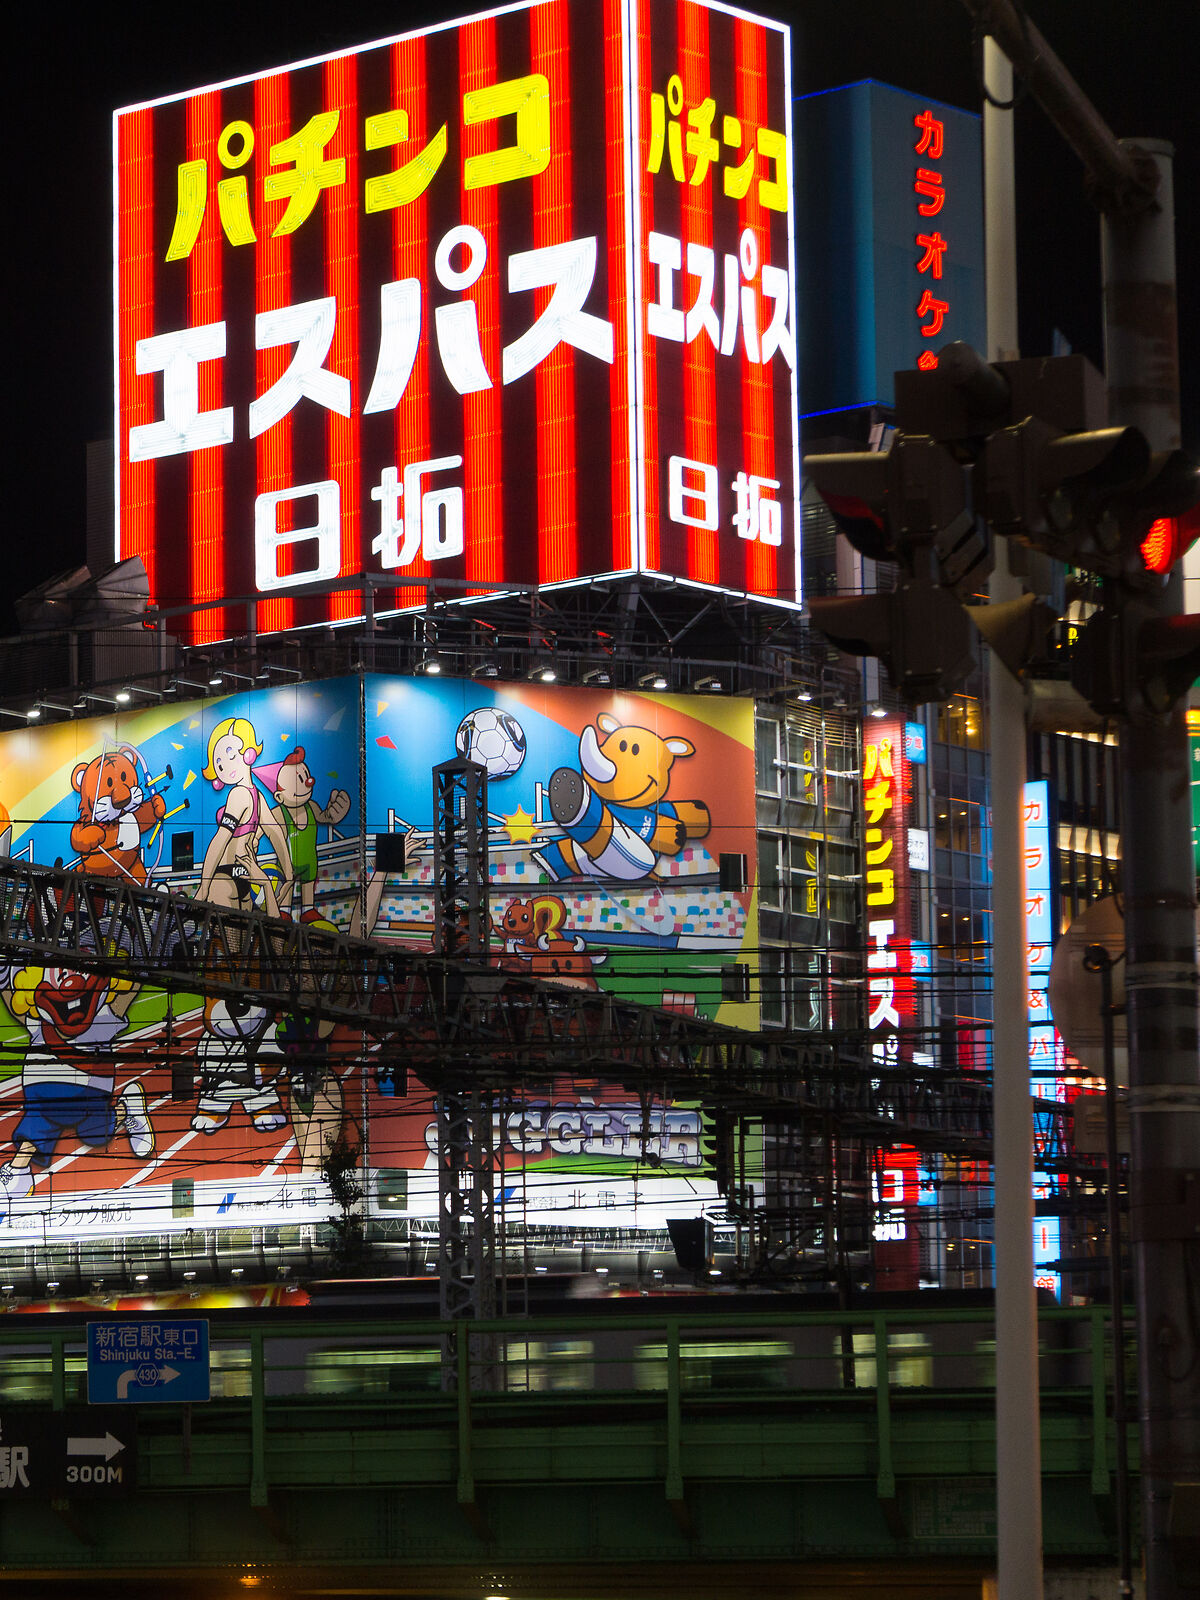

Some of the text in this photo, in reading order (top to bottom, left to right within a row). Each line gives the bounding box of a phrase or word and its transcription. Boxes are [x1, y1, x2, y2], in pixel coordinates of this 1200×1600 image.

[166, 74, 550, 262] パチンコ
[648, 74, 789, 213] パチンコ
[129, 224, 613, 463] エスパス
[648, 228, 792, 371] エスパス
[255, 455, 463, 591] 日拓
[668, 455, 783, 546] 日拓
[864, 737, 895, 906] パチンコ
[96, 1325, 198, 1347] 新宿駅東口
[100, 1349, 150, 1362] Shinjuku
[139, 1370, 157, 1381] 430
[66, 1466, 123, 1484] 300M
